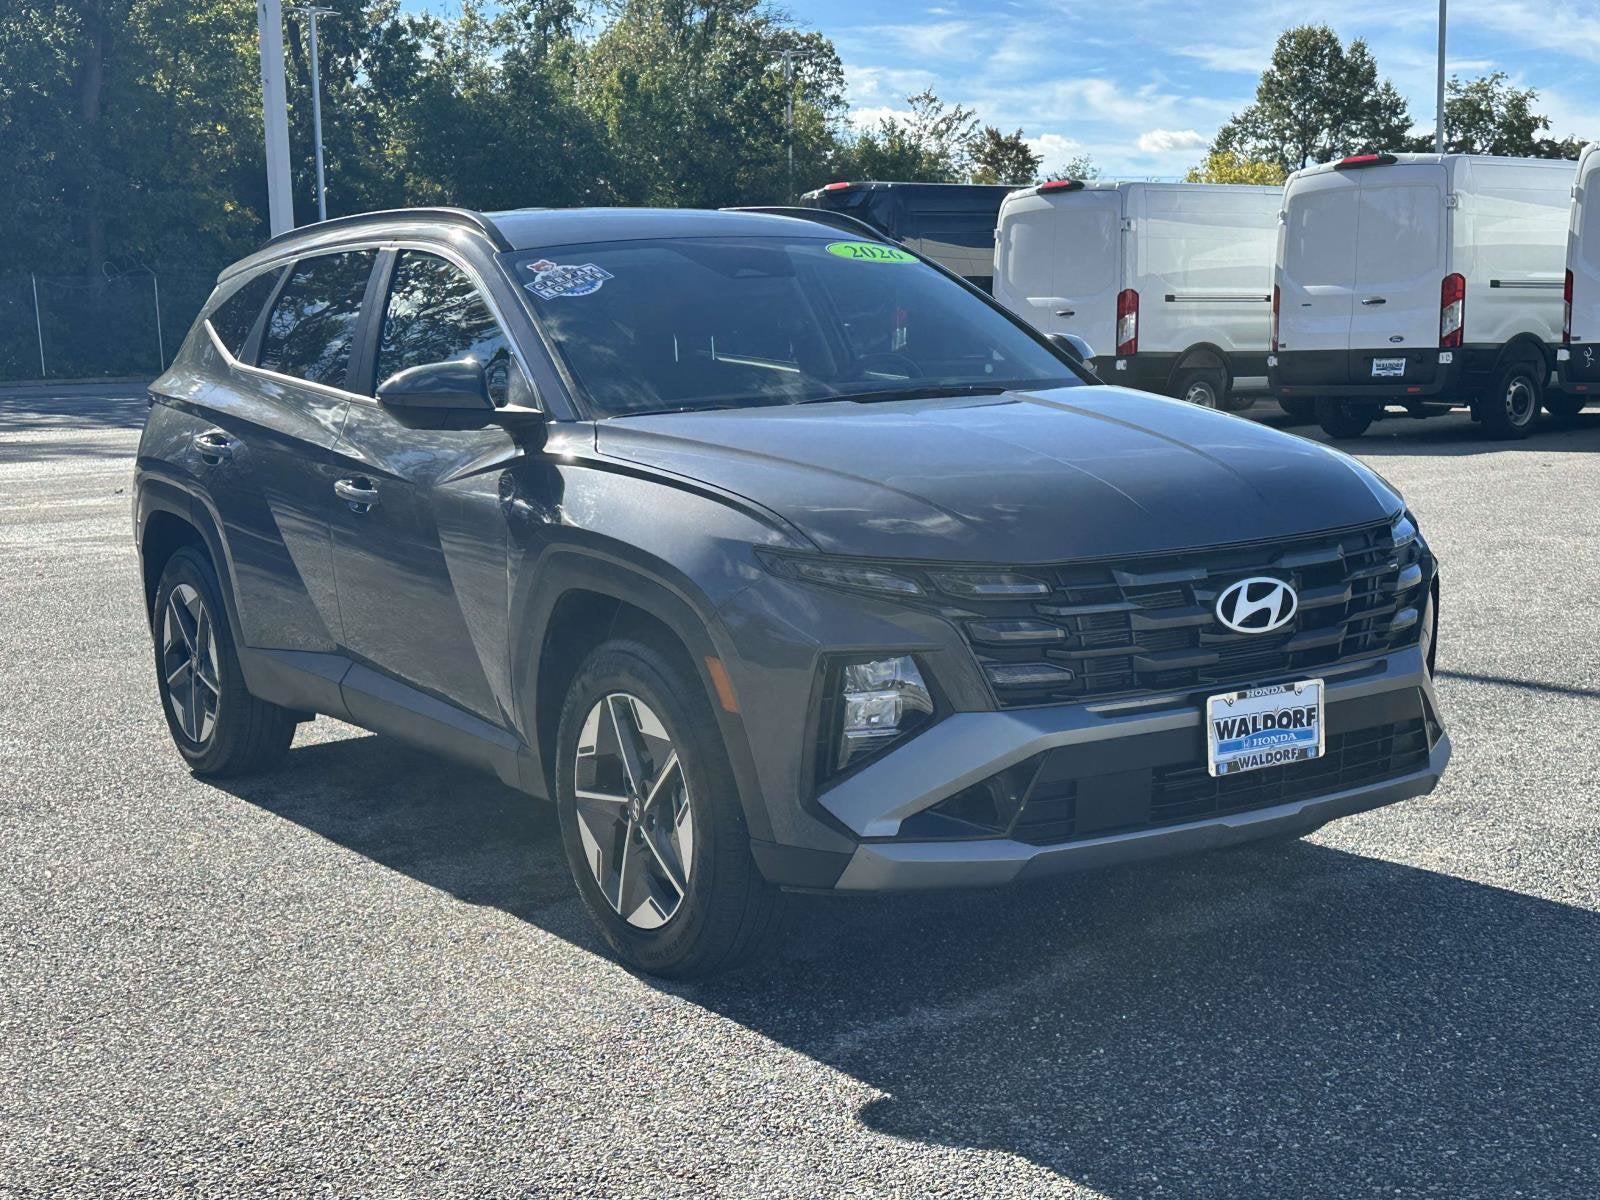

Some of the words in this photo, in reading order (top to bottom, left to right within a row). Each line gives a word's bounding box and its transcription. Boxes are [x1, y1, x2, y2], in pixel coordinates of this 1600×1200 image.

[535, 265, 601, 290] CARFAX
[1246, 685, 1287, 698] HONDA
[1214, 706, 1318, 741] WALDORF
[1251, 732, 1297, 747] HONDA
[1238, 747, 1299, 769] WALDORF
